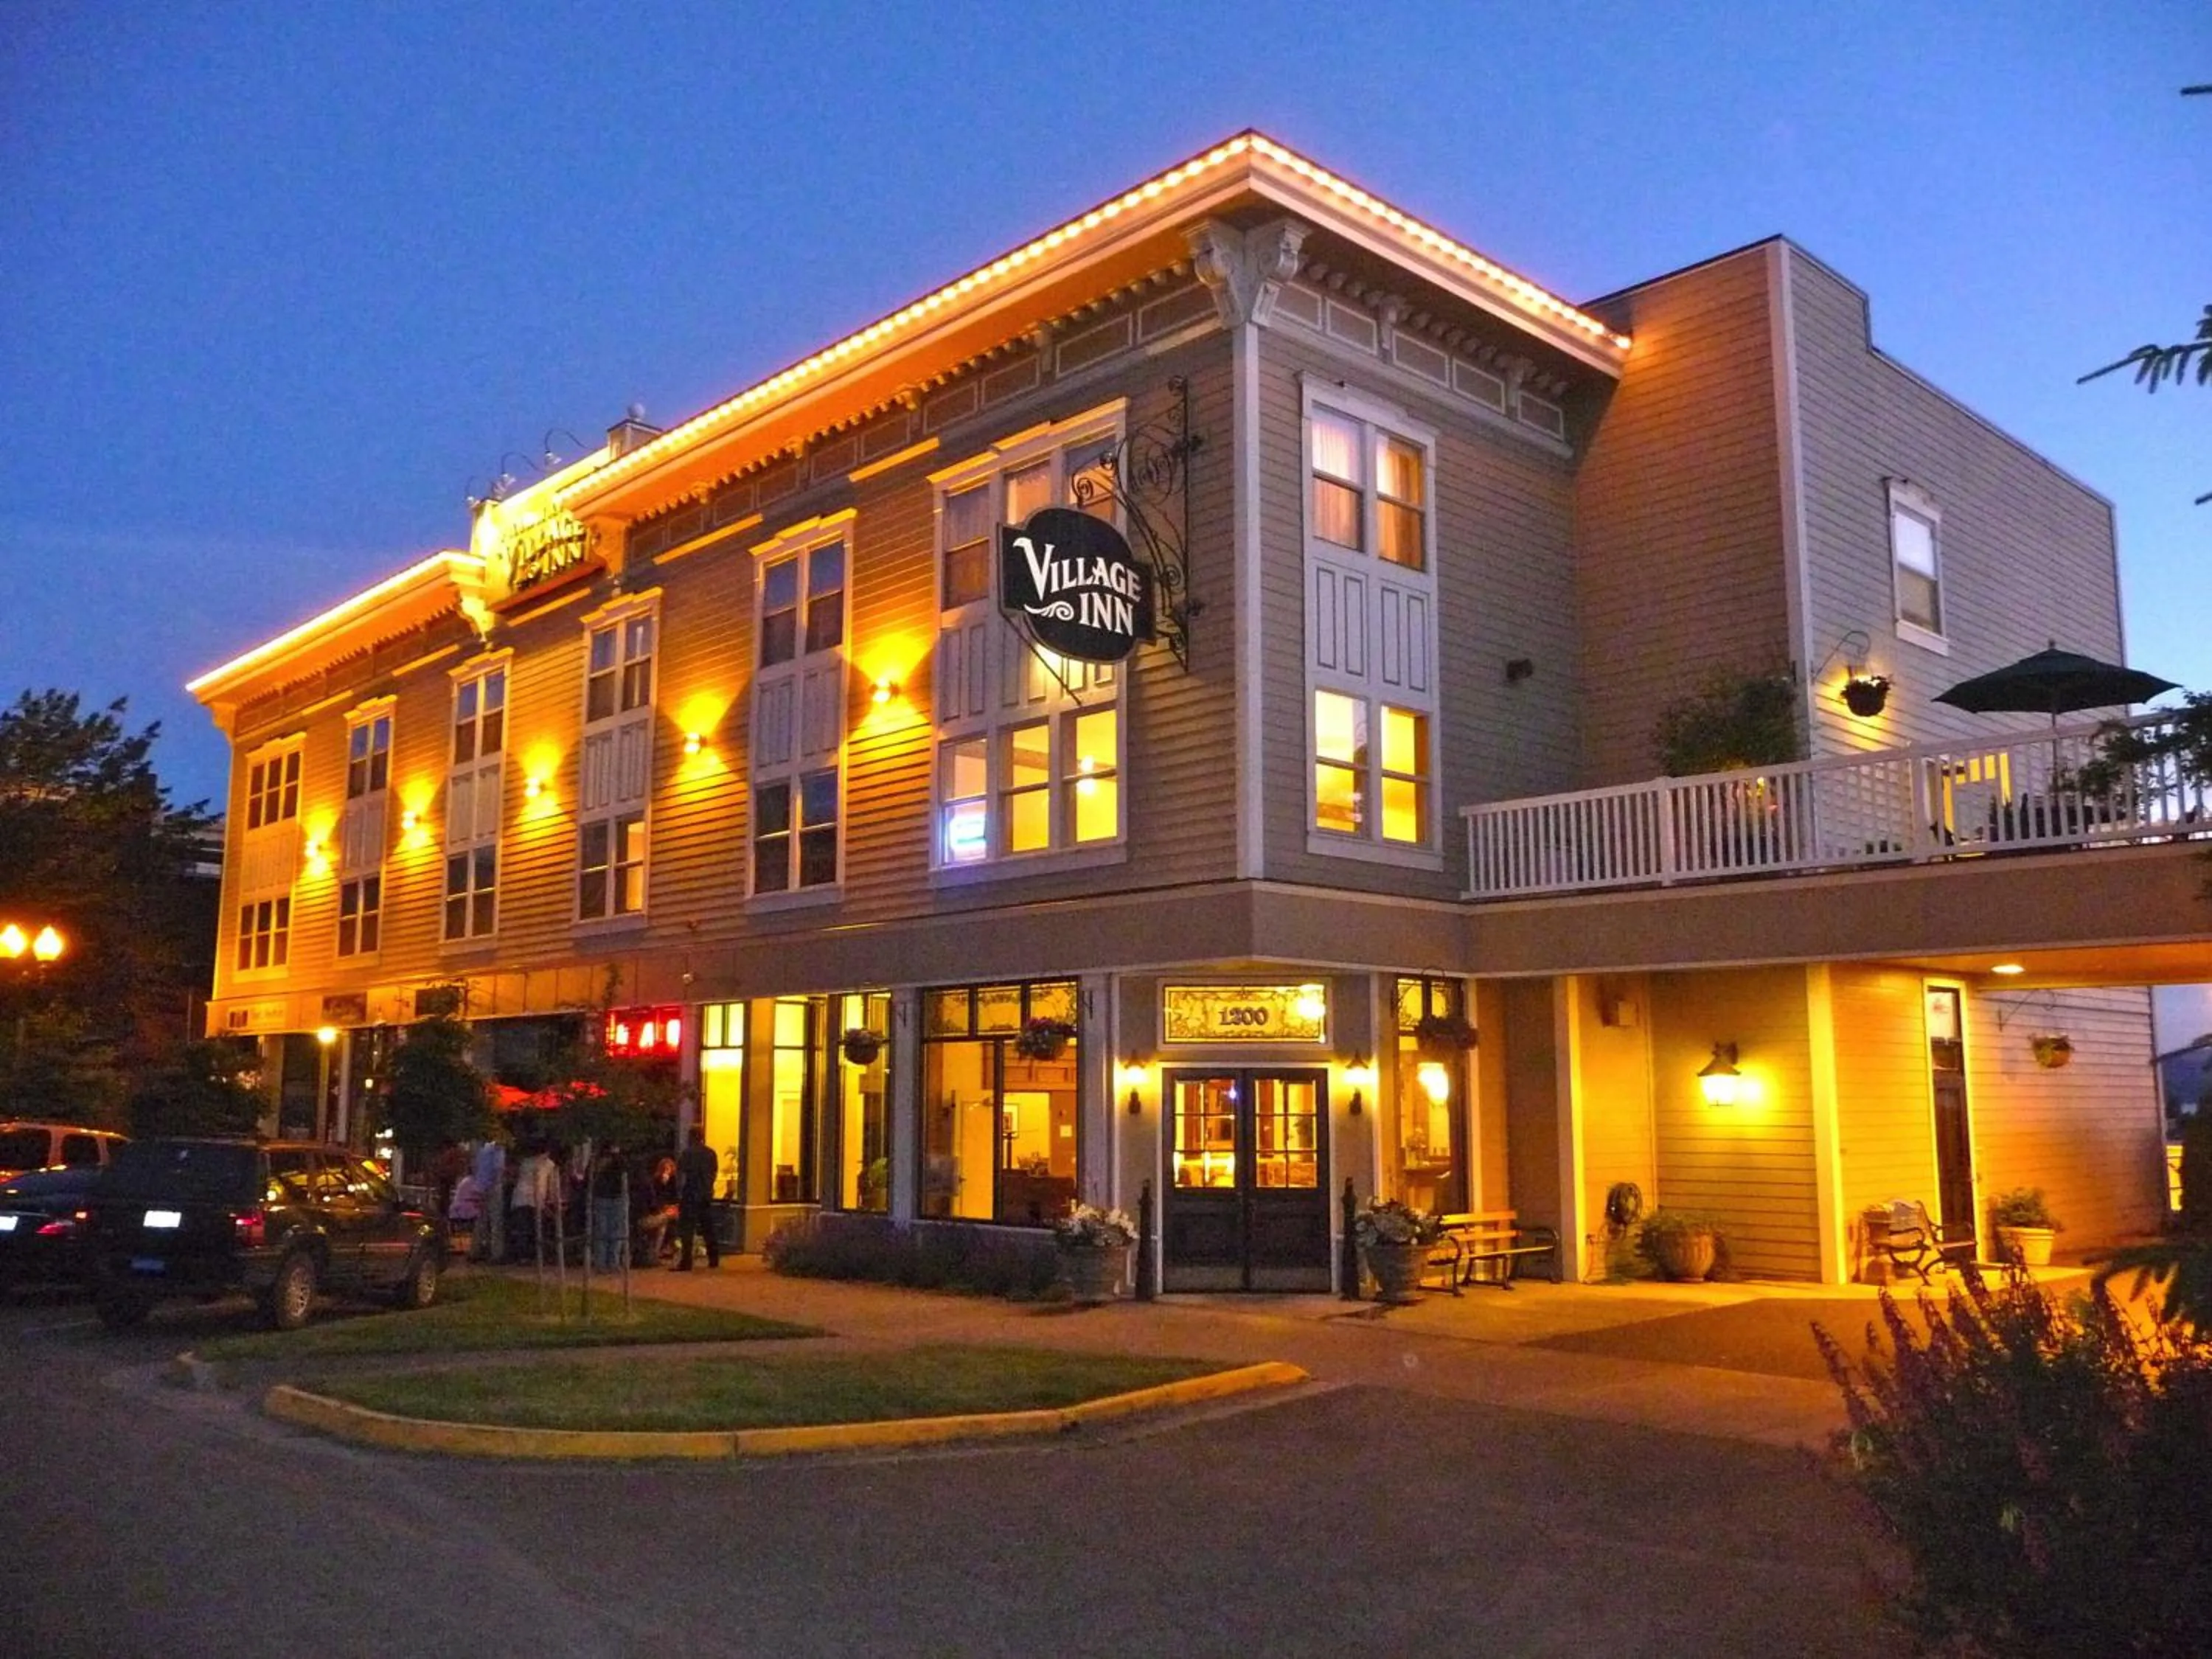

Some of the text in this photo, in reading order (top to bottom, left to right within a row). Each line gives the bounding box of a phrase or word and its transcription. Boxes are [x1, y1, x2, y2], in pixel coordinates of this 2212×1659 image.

[1013, 537, 1142, 602] VILLAGE
[1079, 592, 1133, 636] INN
[1218, 1006, 1268, 1026] 1200
